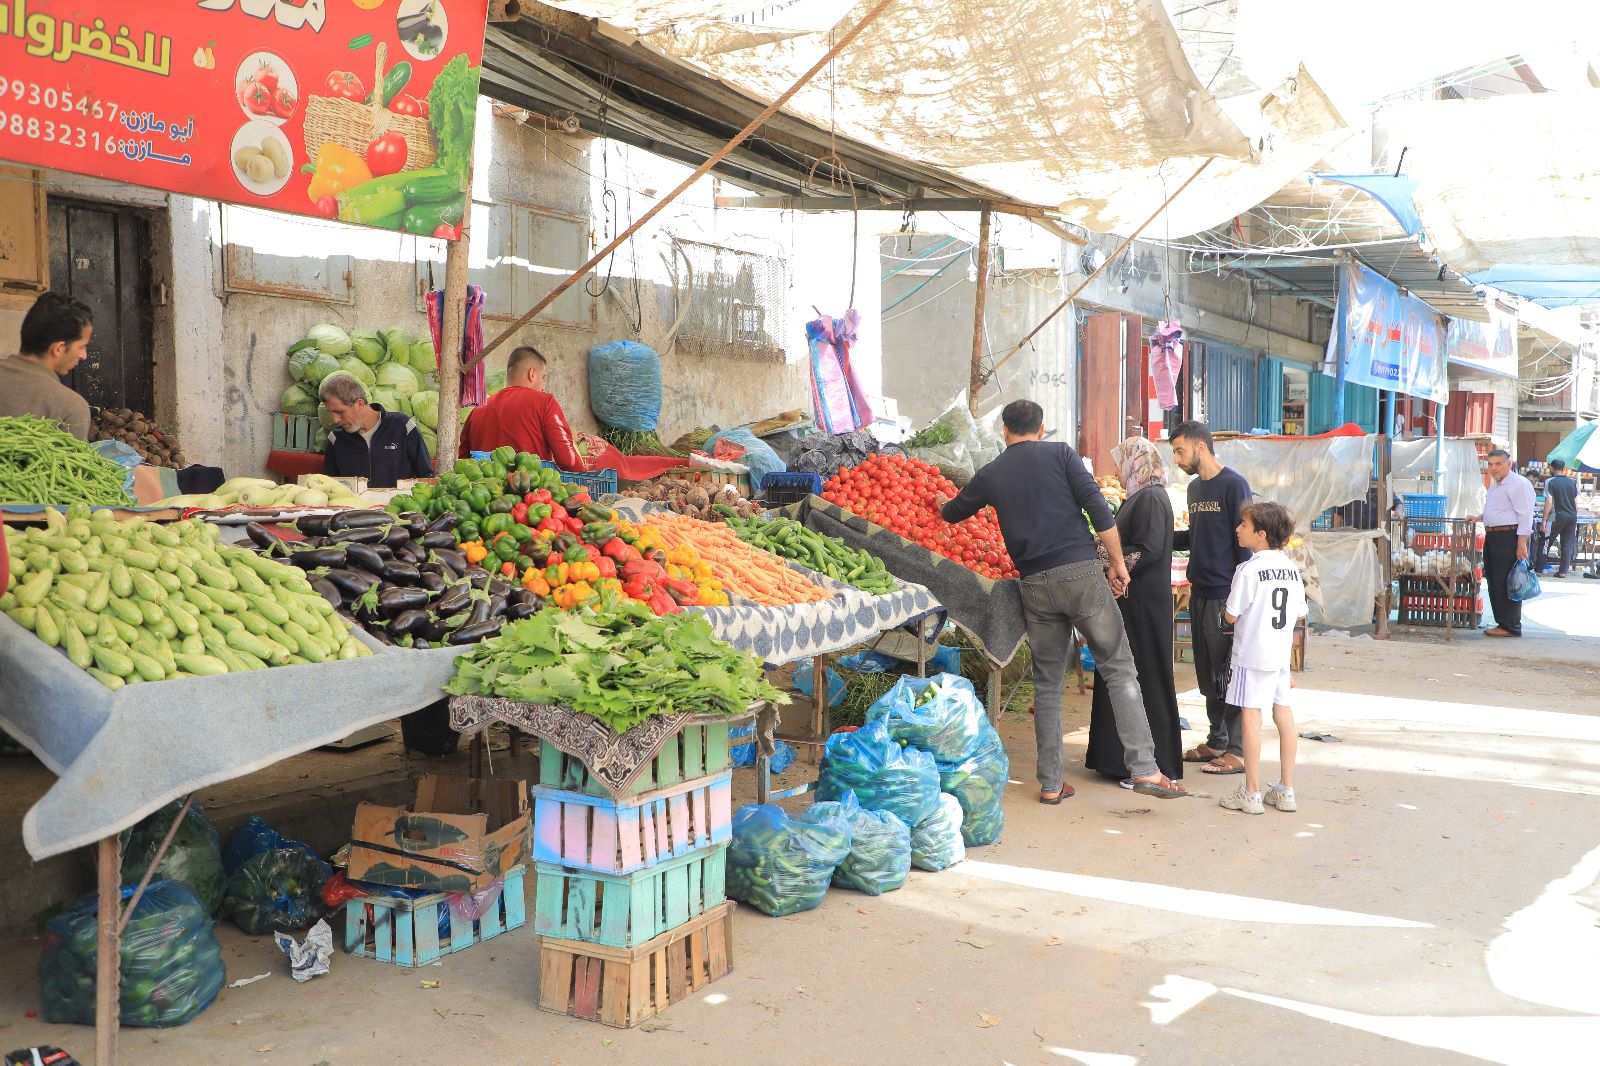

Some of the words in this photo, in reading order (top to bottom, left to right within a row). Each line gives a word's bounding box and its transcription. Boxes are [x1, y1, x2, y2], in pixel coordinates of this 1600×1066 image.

[0, 0, 171, 77] للخضروا
[169, 116, 194, 142] أبو
[1271, 587, 1289, 630] 9
